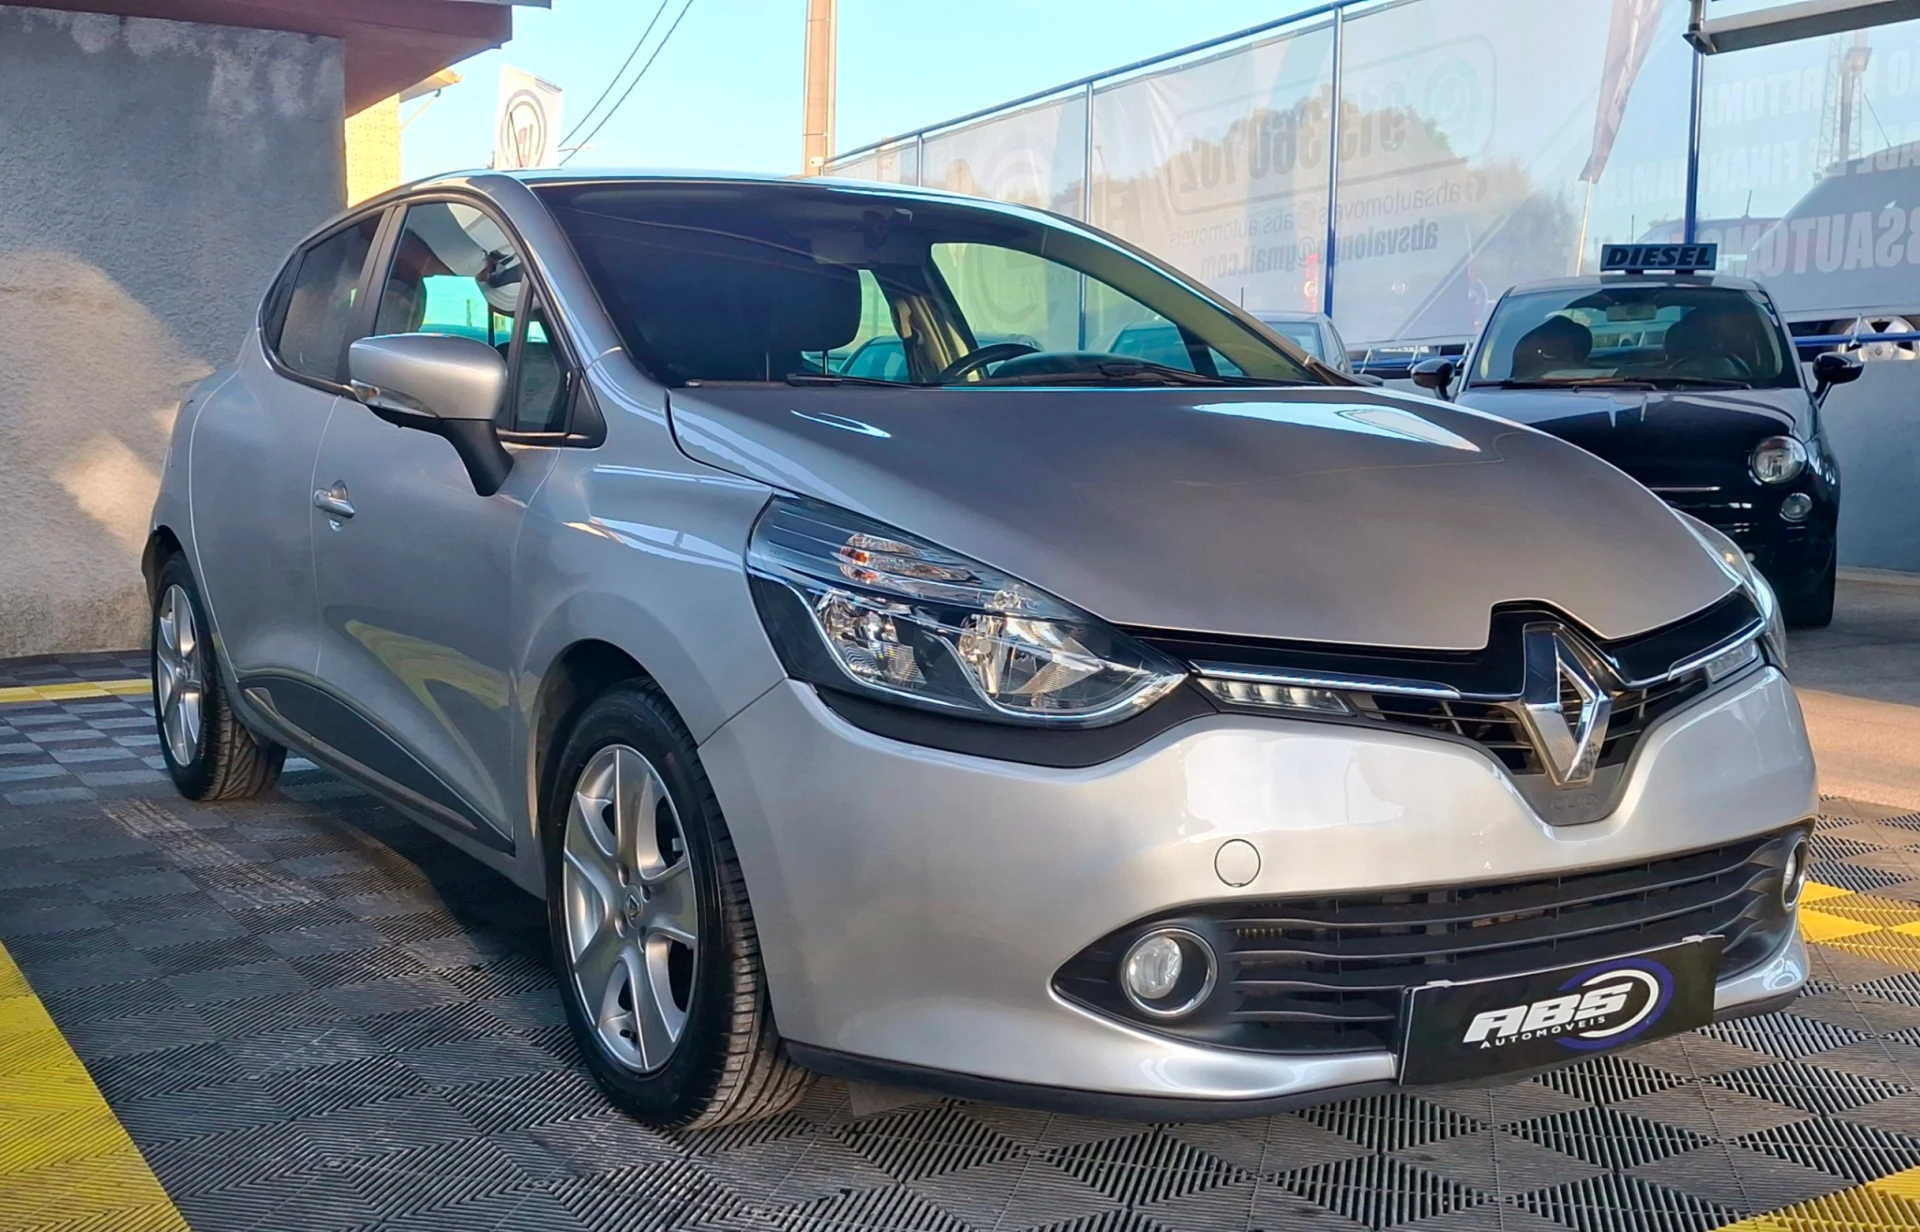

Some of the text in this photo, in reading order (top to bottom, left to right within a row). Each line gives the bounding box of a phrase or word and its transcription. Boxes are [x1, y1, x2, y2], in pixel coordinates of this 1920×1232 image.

[1605, 247, 1711, 266] DIESEL
[1463, 982, 1633, 1043] ABS
[1480, 1015, 1605, 1049] AUTOMOVEIS
